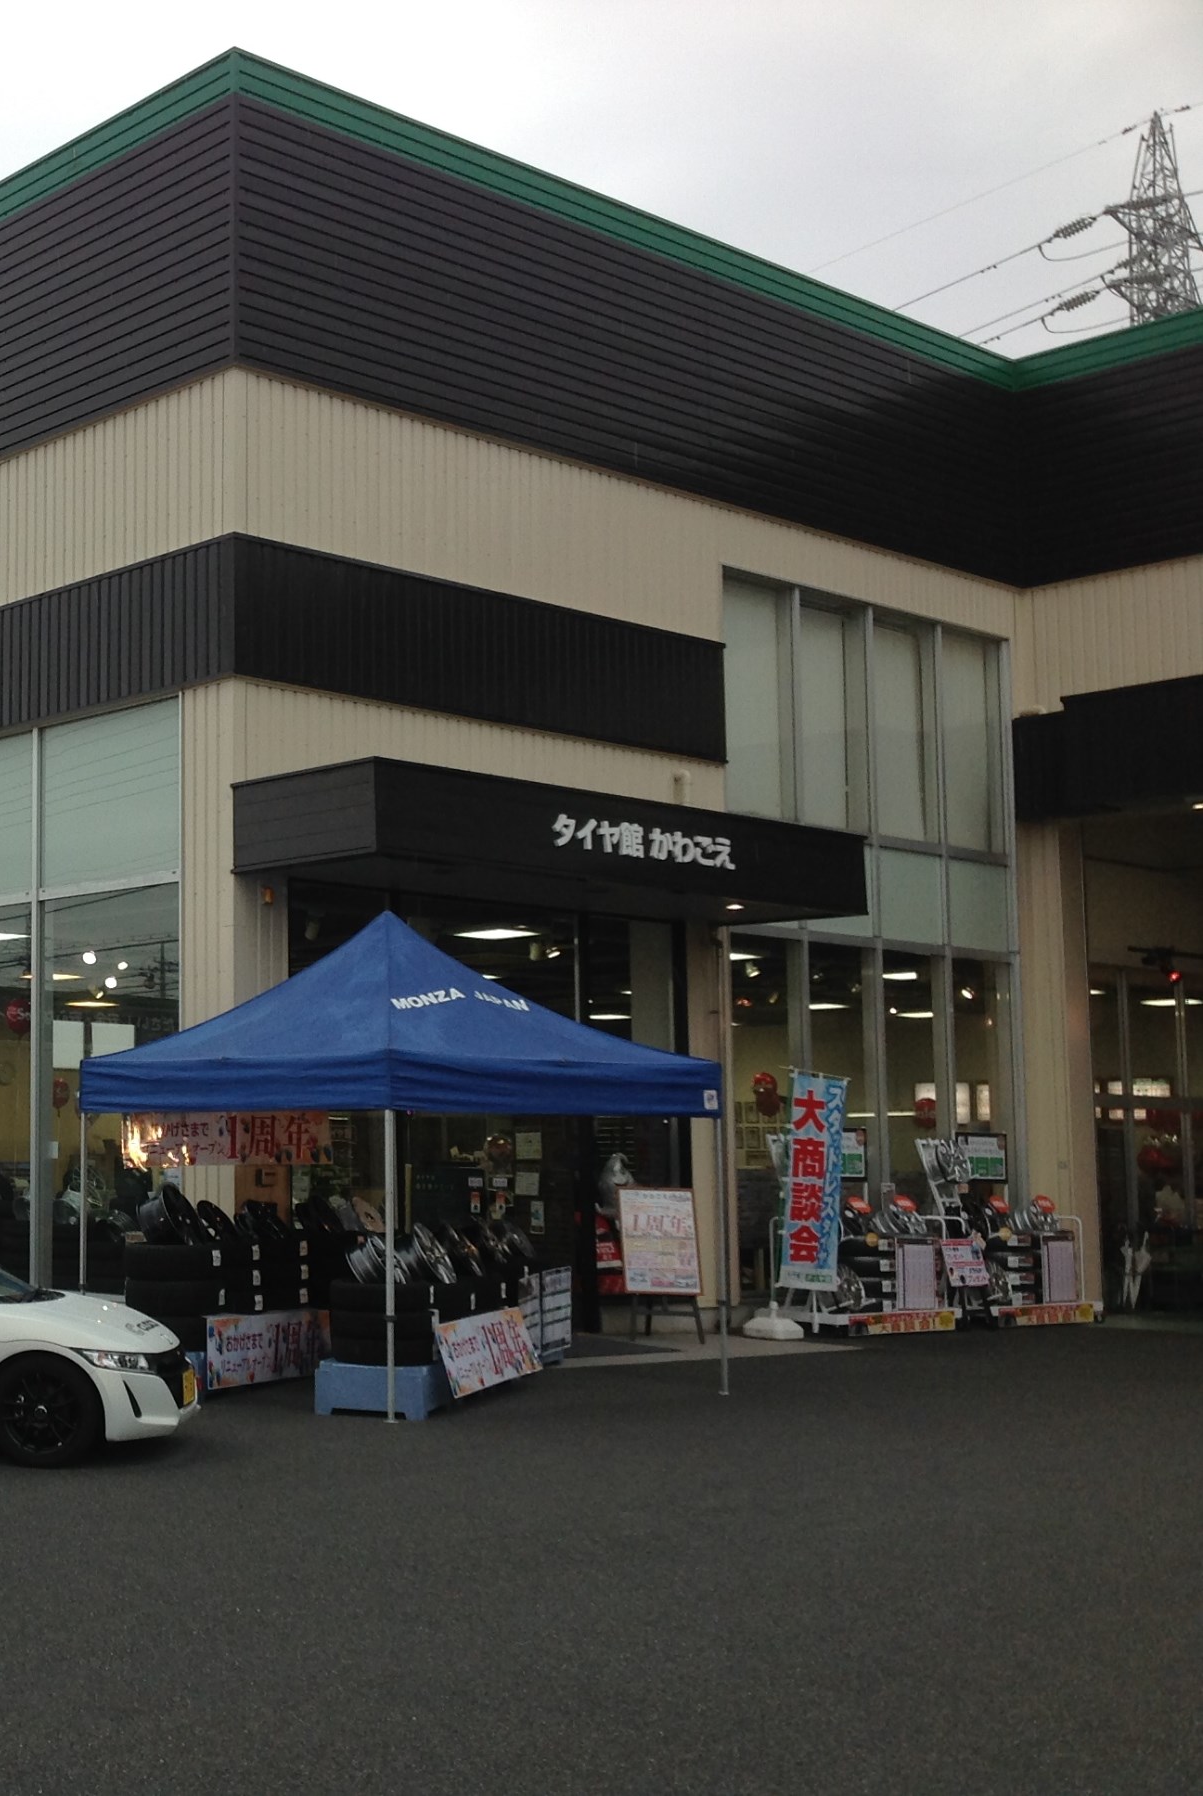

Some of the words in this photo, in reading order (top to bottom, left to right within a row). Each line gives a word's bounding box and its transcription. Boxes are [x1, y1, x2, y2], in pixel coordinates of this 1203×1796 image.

[551, 813, 645, 859] タイヤ館
[390, 987, 466, 1010] MONZA
[474, 990, 530, 1012] JAPAN
[227, 1113, 313, 1161] 1周年
[791, 1089, 826, 1264] 大商談会
